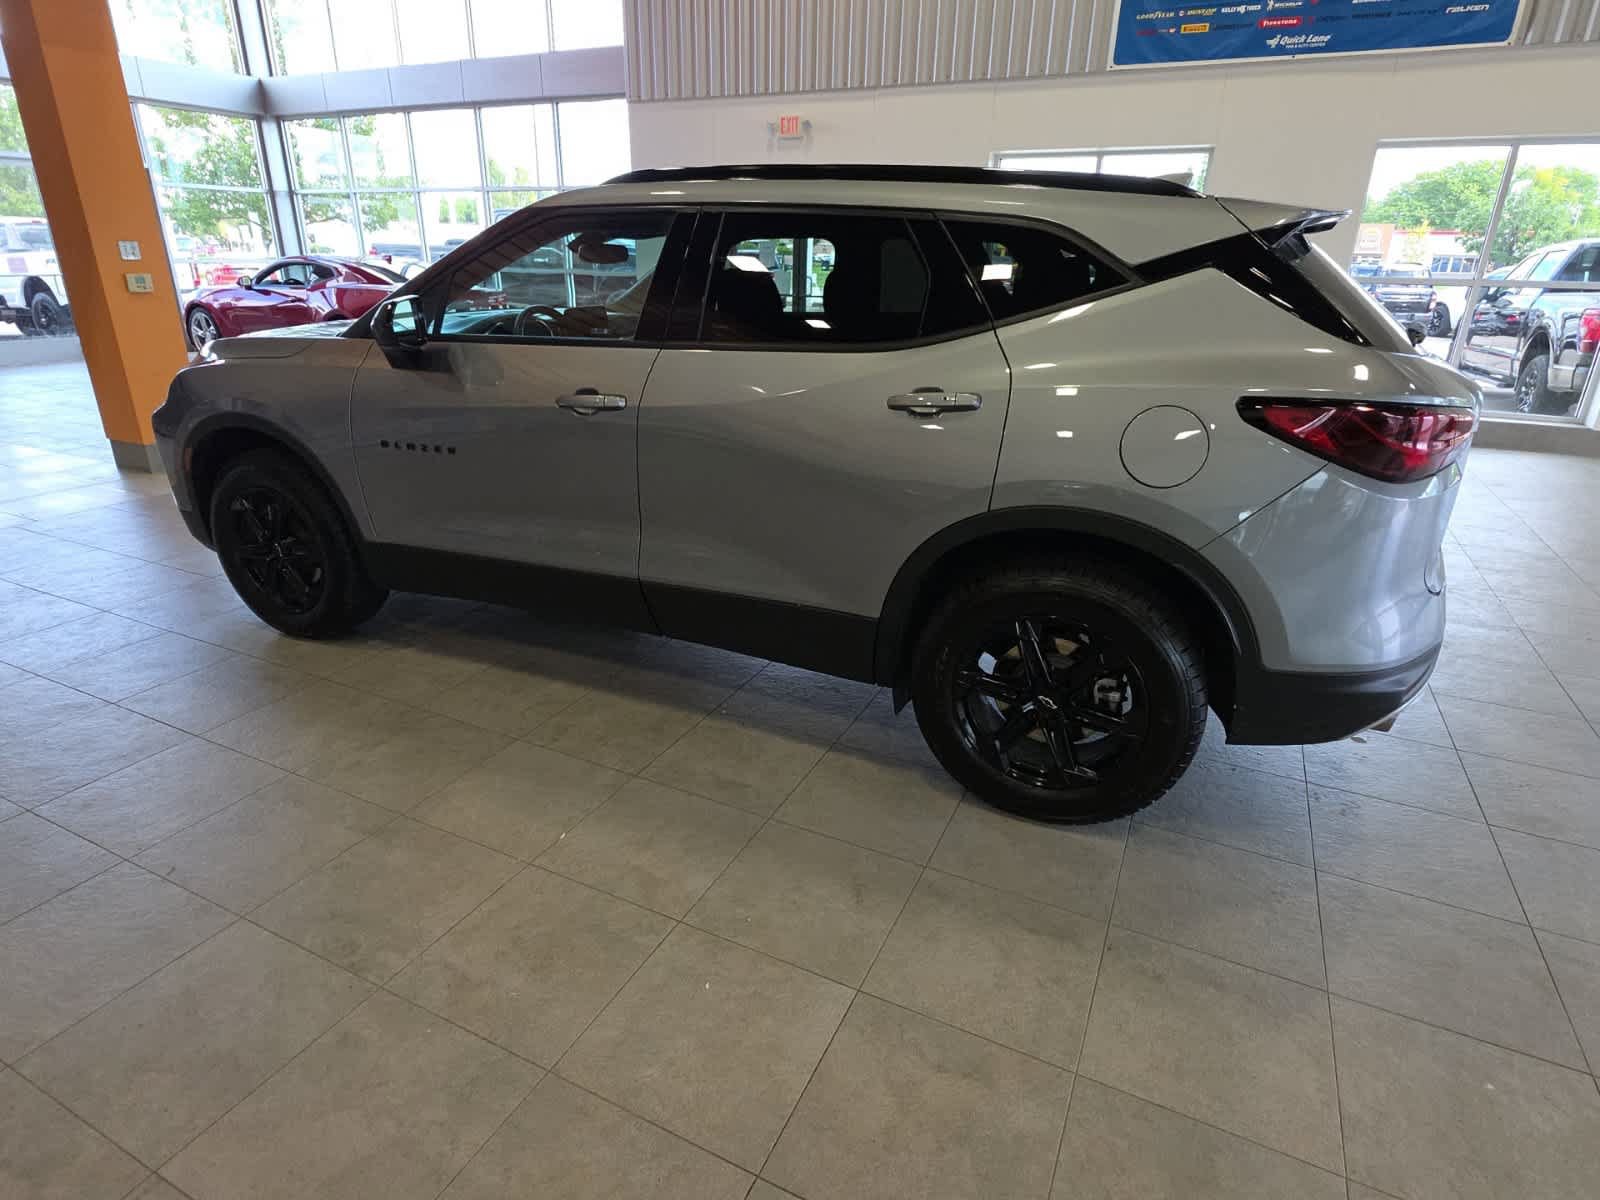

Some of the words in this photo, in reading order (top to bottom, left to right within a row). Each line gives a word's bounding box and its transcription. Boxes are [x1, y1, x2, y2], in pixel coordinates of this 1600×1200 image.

[1445, 4, 1490, 14] FALKEN
[1136, 11, 1175, 20] GOODYEAR
[1280, 34, 1306, 46] Quick
[1307, 34, 1331, 43] Lane
[780, 115, 800, 136] EXIT
[380, 440, 457, 457] BLAZER
